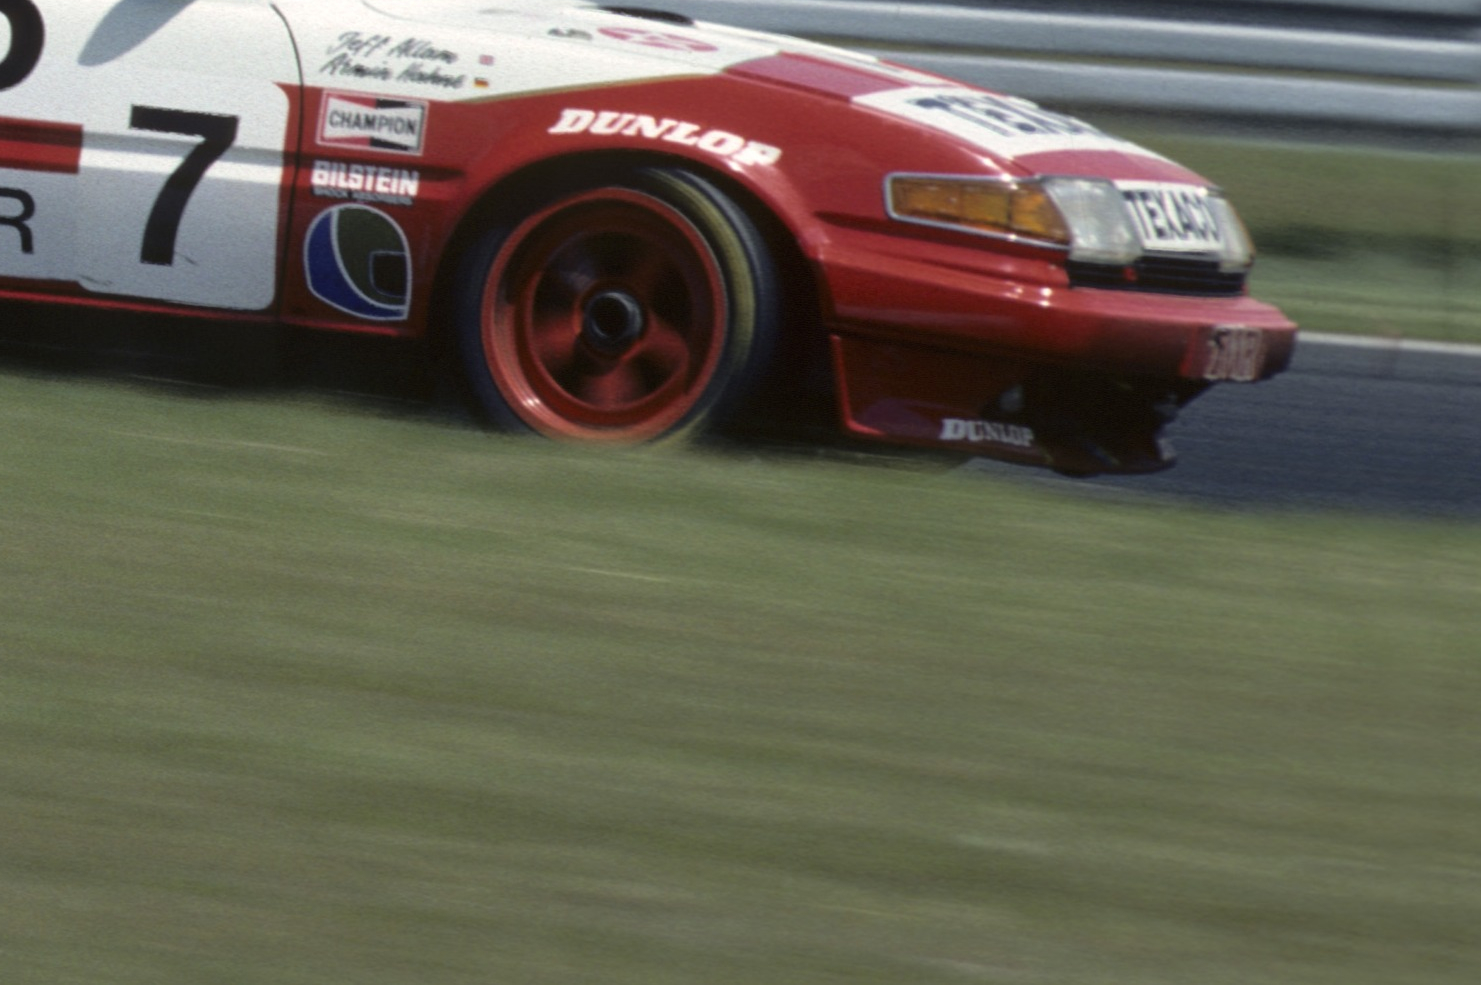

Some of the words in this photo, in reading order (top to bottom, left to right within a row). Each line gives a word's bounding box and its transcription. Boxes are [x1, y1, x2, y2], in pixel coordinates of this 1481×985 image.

[328, 110, 417, 136] CHAMPION
[908, 94, 1108, 139] TEX
[547, 108, 783, 173] DUNLOP
[129, 104, 239, 266] 7
[311, 160, 420, 197] BILSTEIN
[1122, 189, 1221, 243] TEXACO
[939, 418, 1035, 447] DUNLOP
